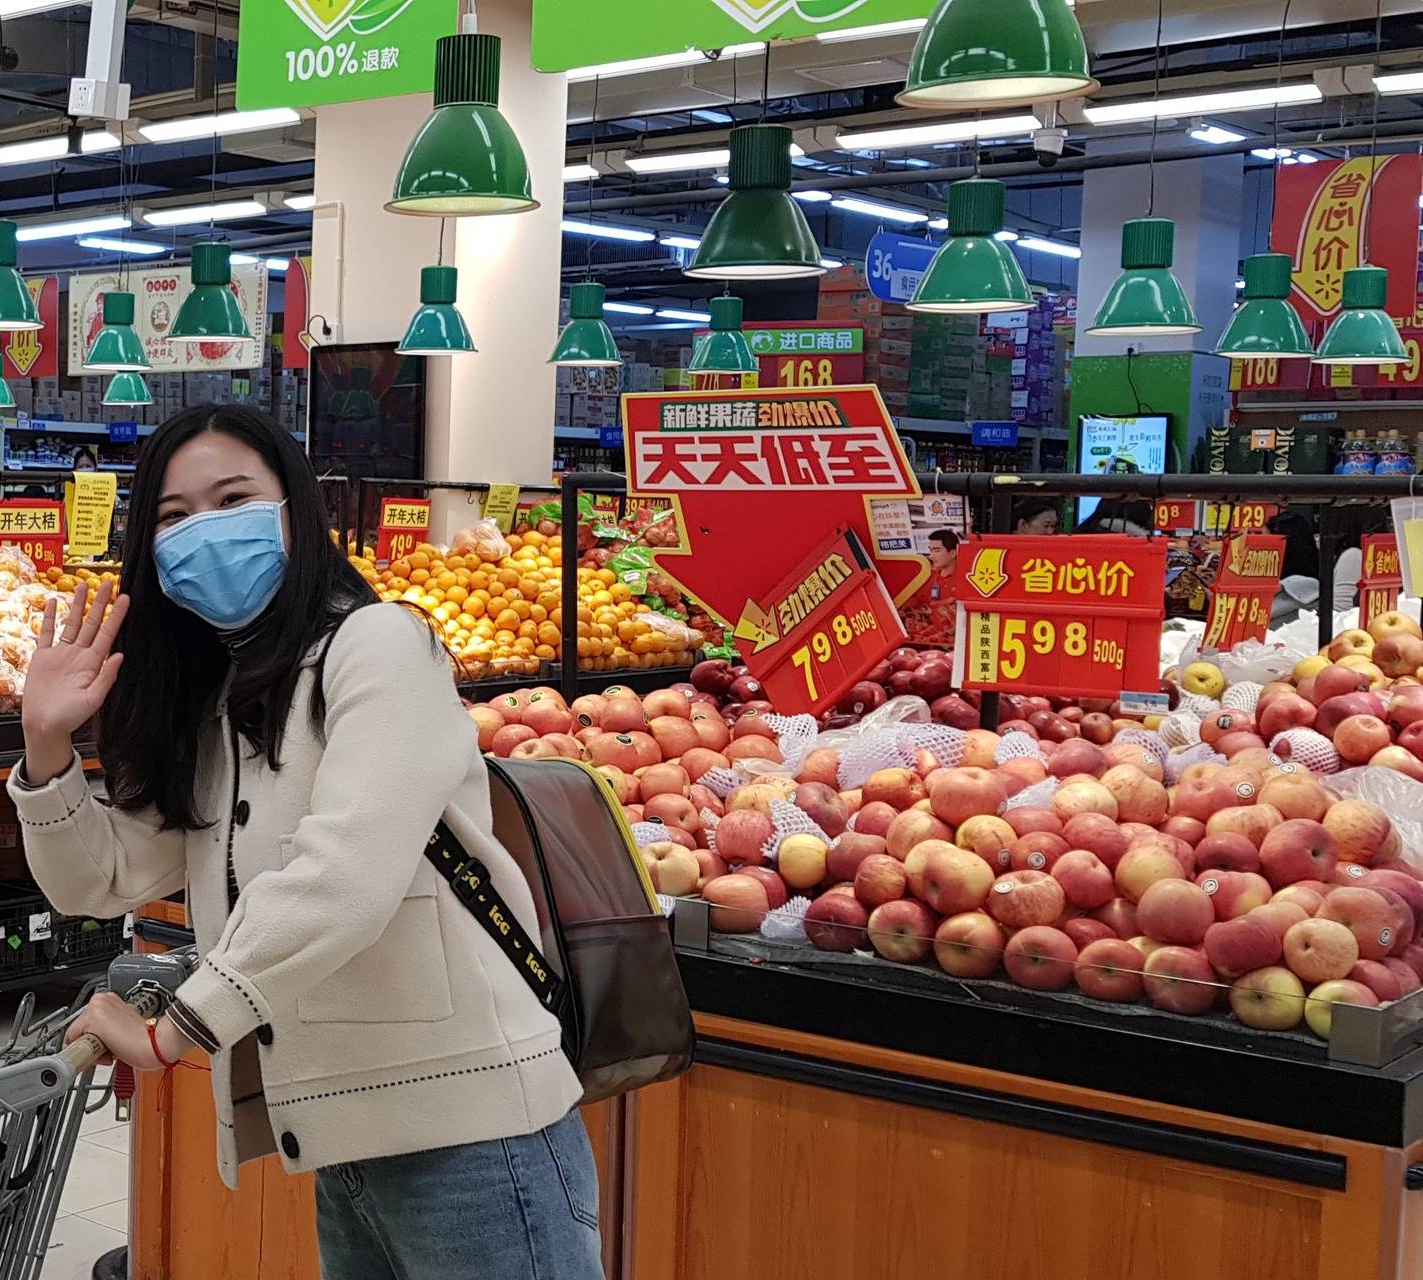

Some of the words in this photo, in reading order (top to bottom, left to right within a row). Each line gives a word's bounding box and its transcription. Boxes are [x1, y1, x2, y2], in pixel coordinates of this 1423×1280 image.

[285, 41, 359, 82] 100%
[361, 46, 399, 73] 退款
[1312, 173, 1367, 272] 省心价
[872, 249, 893, 281] 36
[779, 331, 853, 350] 进口商品
[780, 358, 834, 387] 168
[663, 400, 843, 429] 新鲜果蔬劲爆价
[642, 433, 898, 486] 天天低至
[0, 512, 56, 531] 开年大桔
[387, 508, 427, 524] 开年大桔
[1233, 505, 1265, 528] 129
[1021, 558, 1135, 597] 省心价
[777, 553, 853, 635] 劲爆价
[792, 613, 853, 702] 798
[852, 610, 878, 637] 500g
[1000, 618, 1087, 680] 598
[1093, 639, 1125, 671] 500g
[488, 904, 511, 936] IGG
[525, 952, 547, 983] IGG
